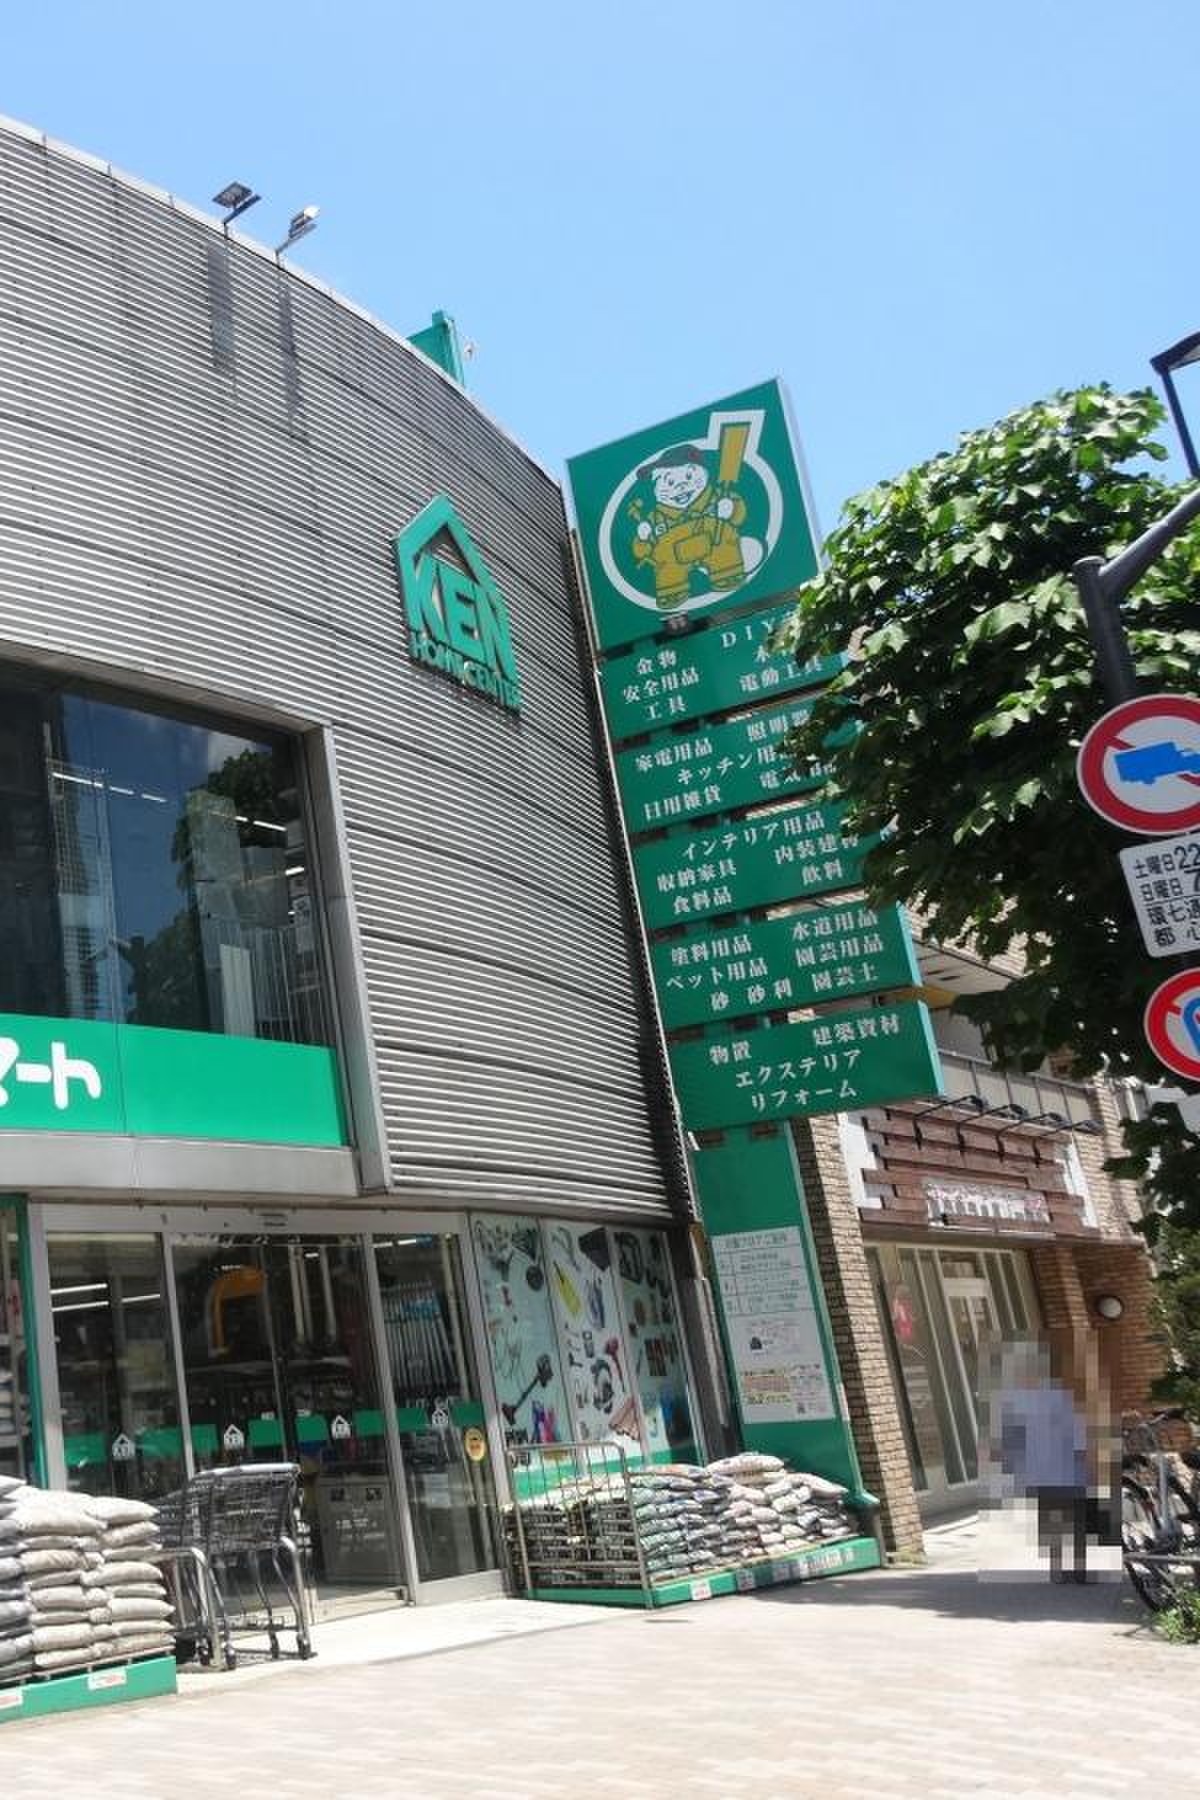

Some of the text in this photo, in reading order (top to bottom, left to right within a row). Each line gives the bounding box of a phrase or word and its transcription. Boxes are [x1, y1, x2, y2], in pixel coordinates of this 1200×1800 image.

[637, 650, 676, 674] 金物
[624, 667, 699, 703] 安全用品
[645, 696, 686, 720] 工具
[635, 738, 713, 772] 家電用品
[643, 784, 721, 821] 日用雑貨
[683, 811, 825, 860] インテリア用品
[657, 859, 736, 893] 収納家具
[802, 859, 843, 885] 飲料
[1133, 854, 1175, 879] 土曜日
[673, 886, 732, 915] 食料品
[1140, 877, 1183, 901] 日曜日
[792, 909, 878, 941] 水道用品
[671, 934, 752, 967] 塗料用品
[795, 933, 884, 968] 園芸用品
[666, 958, 768, 990] ペット用品
[811, 961, 879, 993] 園芸土
[812, 1013, 900, 1046] 建築資材
[709, 1041, 751, 1066] 物置
[735, 1049, 862, 1089] エクステリア
[751, 1079, 858, 1113] リフォーム
